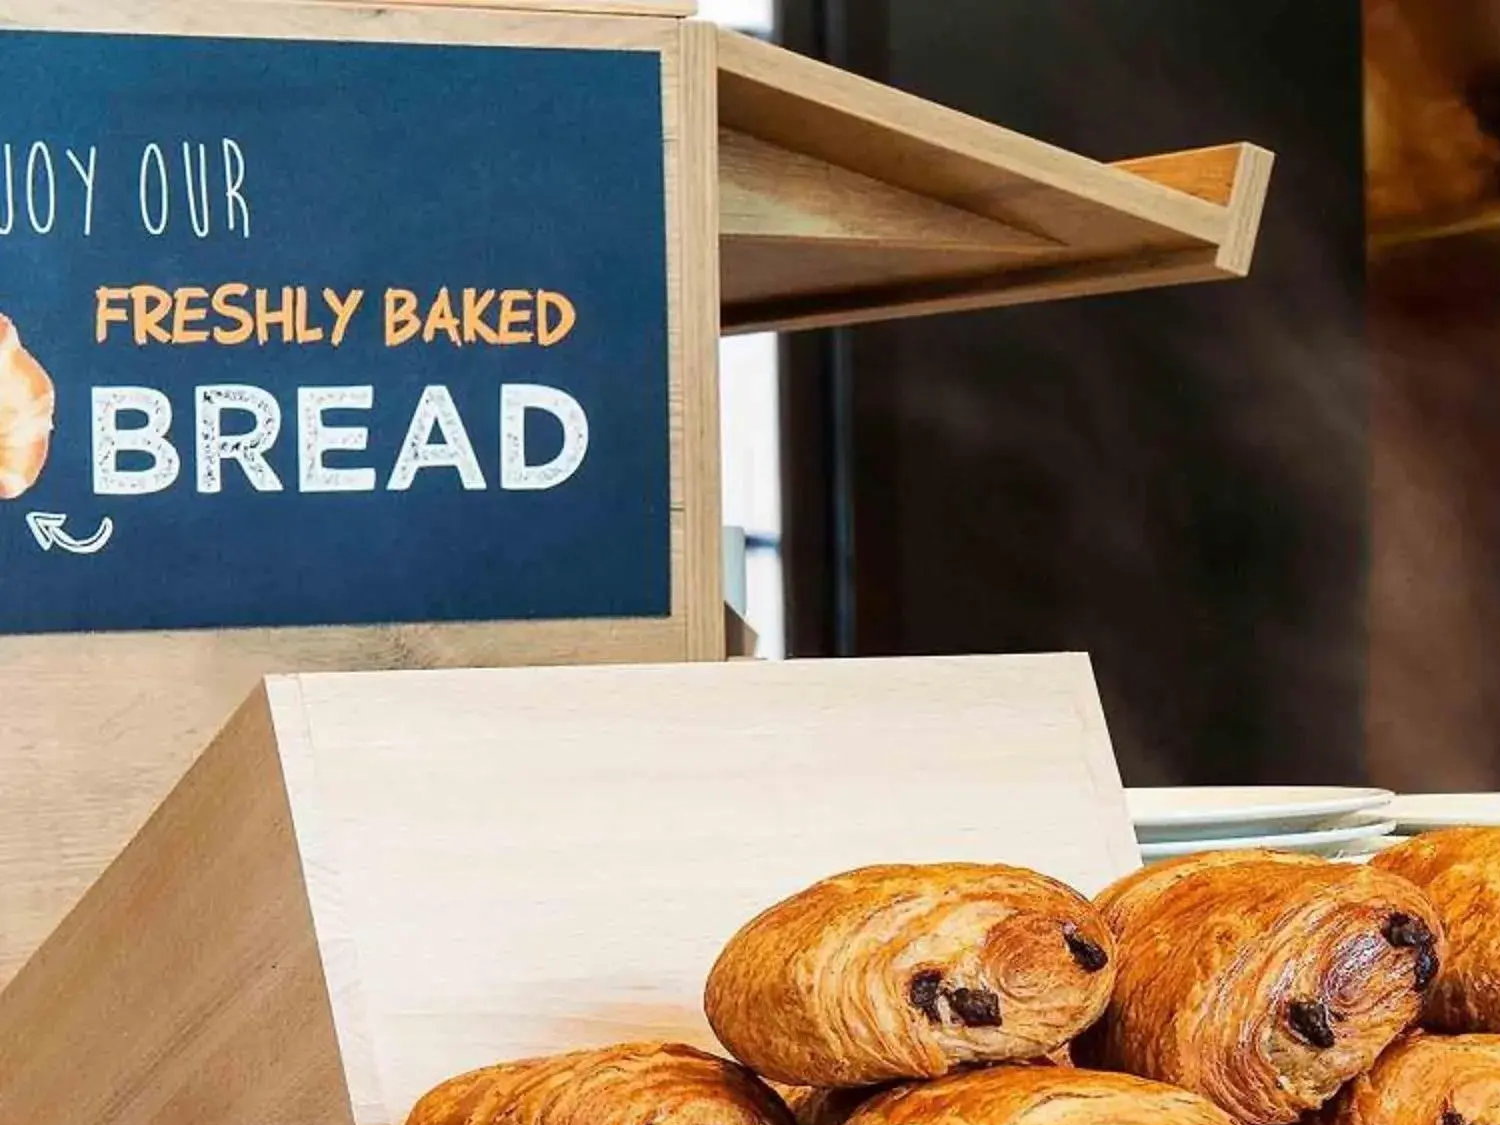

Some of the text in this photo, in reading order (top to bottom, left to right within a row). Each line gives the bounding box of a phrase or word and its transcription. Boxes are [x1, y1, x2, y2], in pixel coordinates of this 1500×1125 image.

[139, 138, 249, 238] OUR
[95, 283, 576, 347] FRESHLY BAKED
[91, 384, 589, 495] BREAD
